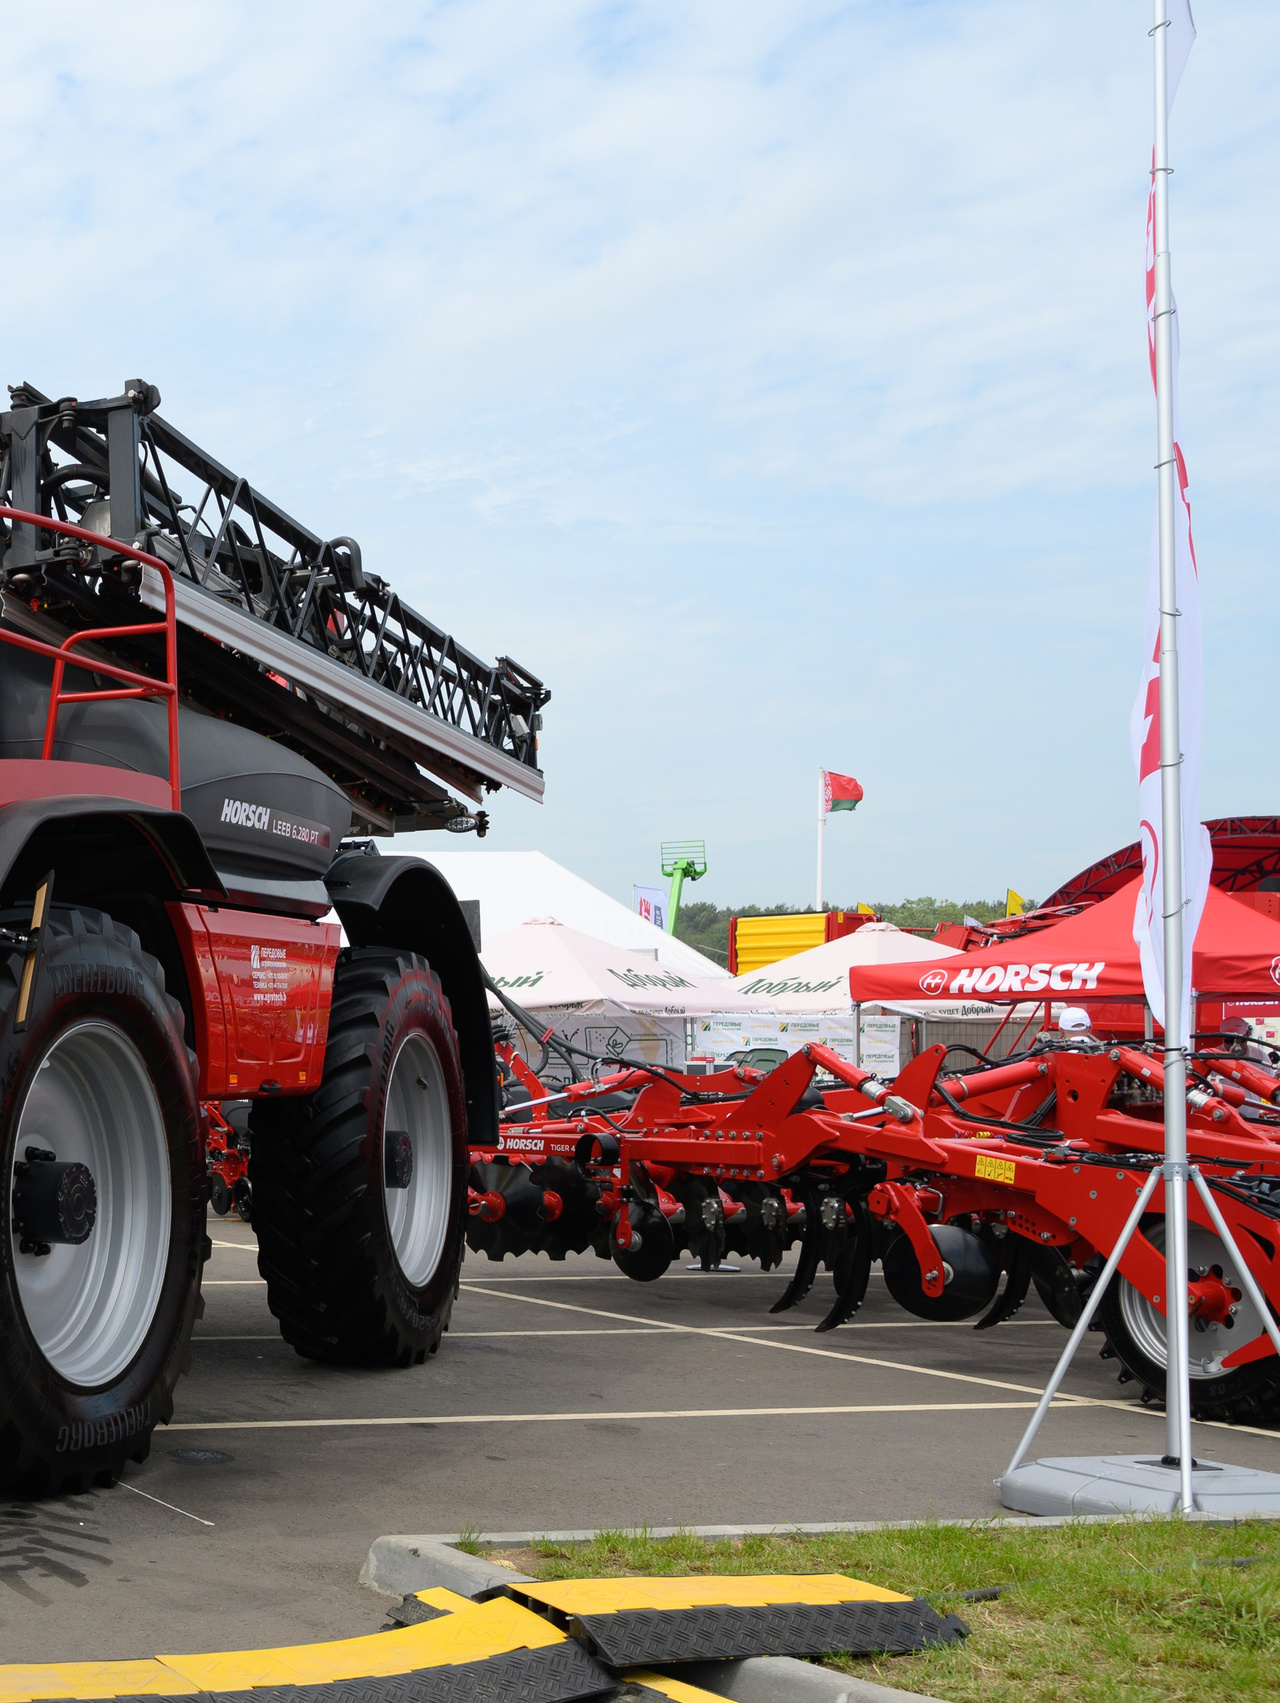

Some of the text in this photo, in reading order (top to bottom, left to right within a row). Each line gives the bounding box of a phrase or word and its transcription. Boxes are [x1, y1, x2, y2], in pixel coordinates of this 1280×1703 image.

[220, 798, 320, 844] HORSCH LEEB 6.280 PT
[46, 963, 145, 997] TRELLEBORG
[607, 968, 698, 991] Добрый
[737, 975, 845, 998] Добрый
[949, 961, 1105, 994] HORSCH
[961, 1003, 994, 1017] Добрый
[506, 1138, 544, 1151] HORSCH
[550, 1144, 570, 1152] TIGER
[55, 1400, 152, 1453] TRELLEBORG
